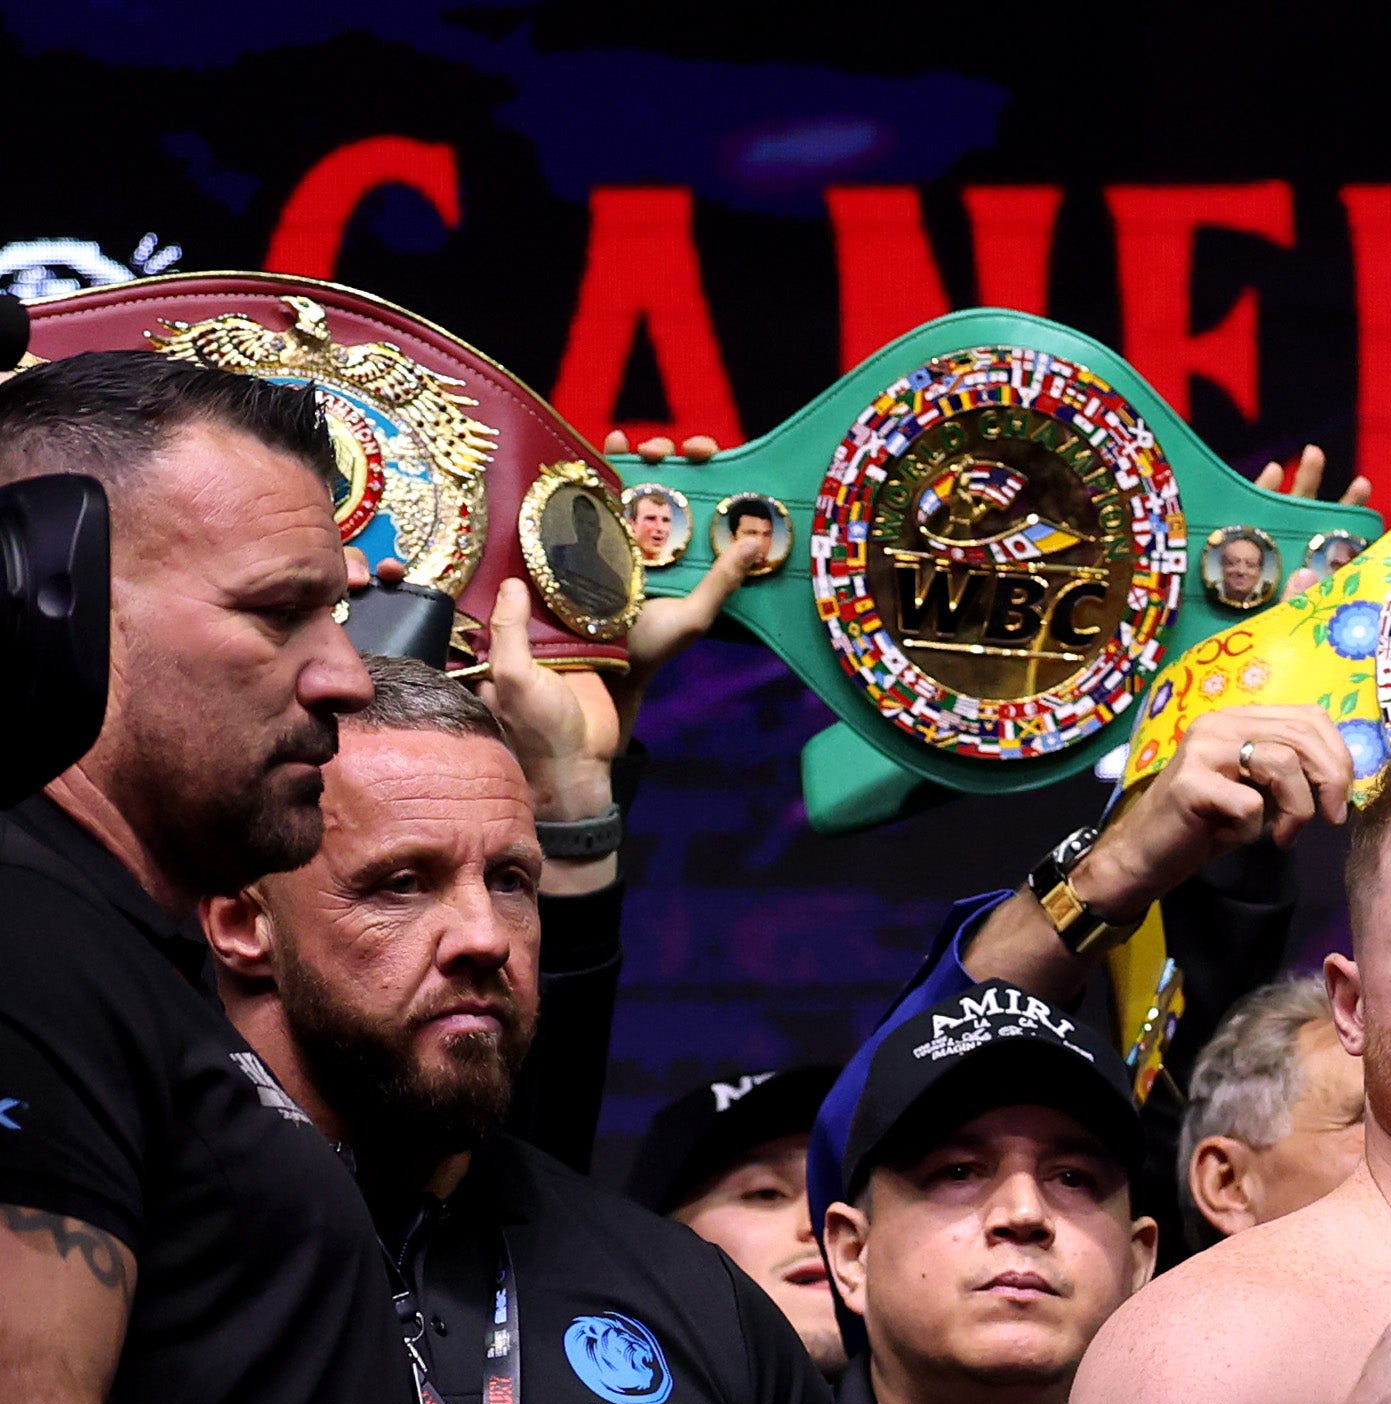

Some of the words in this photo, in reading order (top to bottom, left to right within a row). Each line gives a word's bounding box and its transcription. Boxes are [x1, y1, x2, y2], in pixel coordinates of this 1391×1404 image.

[873, 422, 965, 541] WORLD
[979, 409, 1130, 560] CHAMPION
[894, 560, 1110, 649] WBC
[932, 987, 1075, 1039] AMIRI
